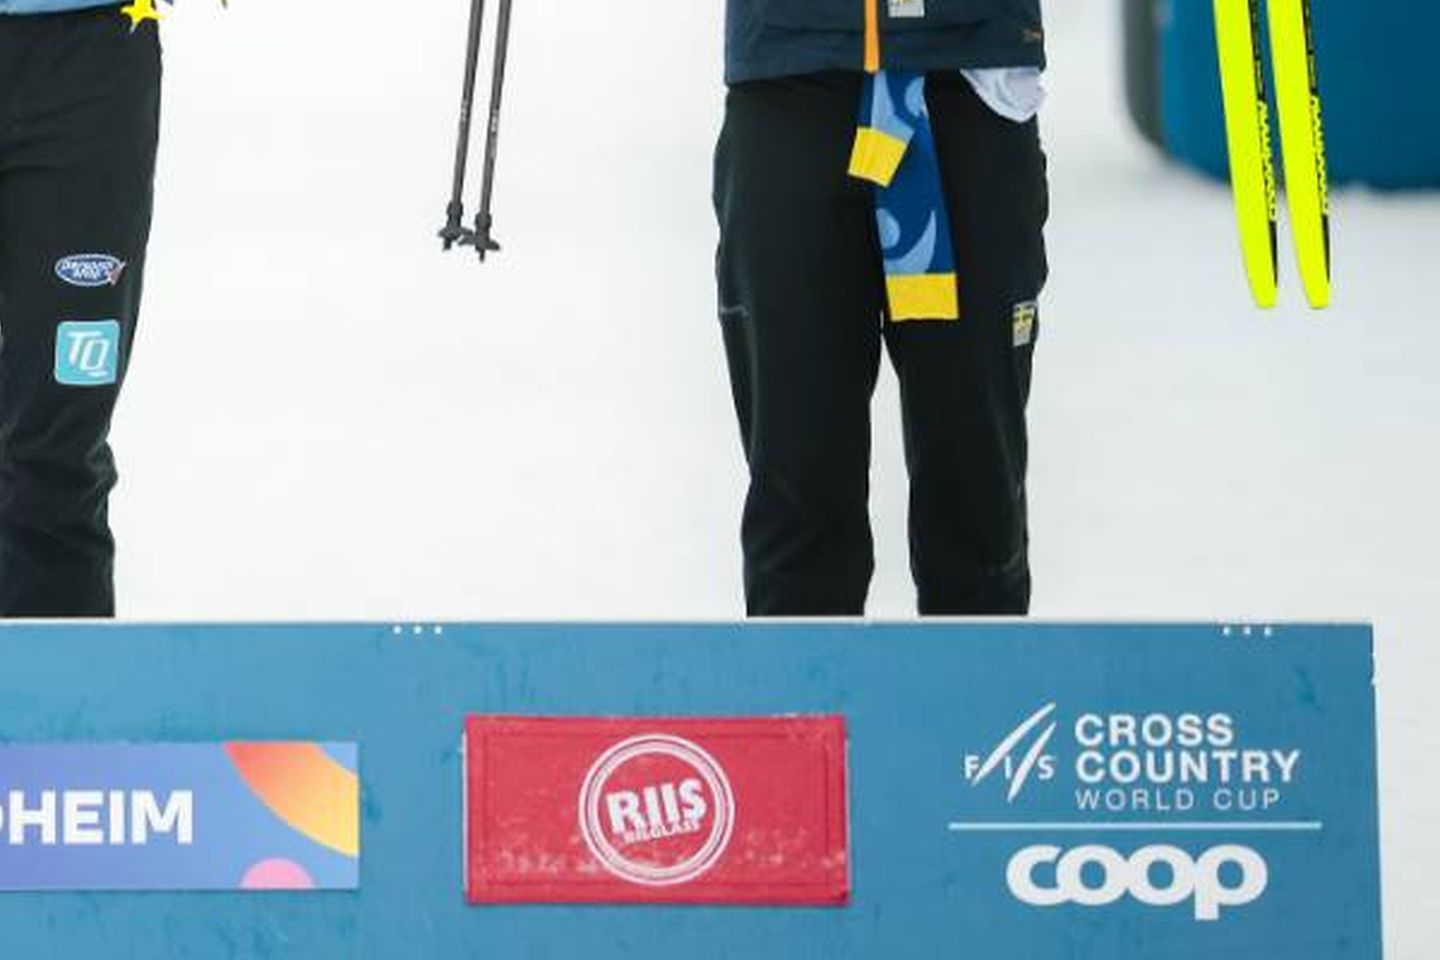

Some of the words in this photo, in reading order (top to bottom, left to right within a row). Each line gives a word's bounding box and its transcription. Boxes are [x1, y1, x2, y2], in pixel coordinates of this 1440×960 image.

[66, 330, 110, 378] TQ
[1074, 713, 1234, 746] CROSS
[1075, 749, 1301, 783] COUNTRY
[606, 777, 707, 835] RIIS
[1075, 788, 1195, 811] WORLD
[1213, 788, 1281, 811] CUP
[1005, 843, 1269, 921] coop
